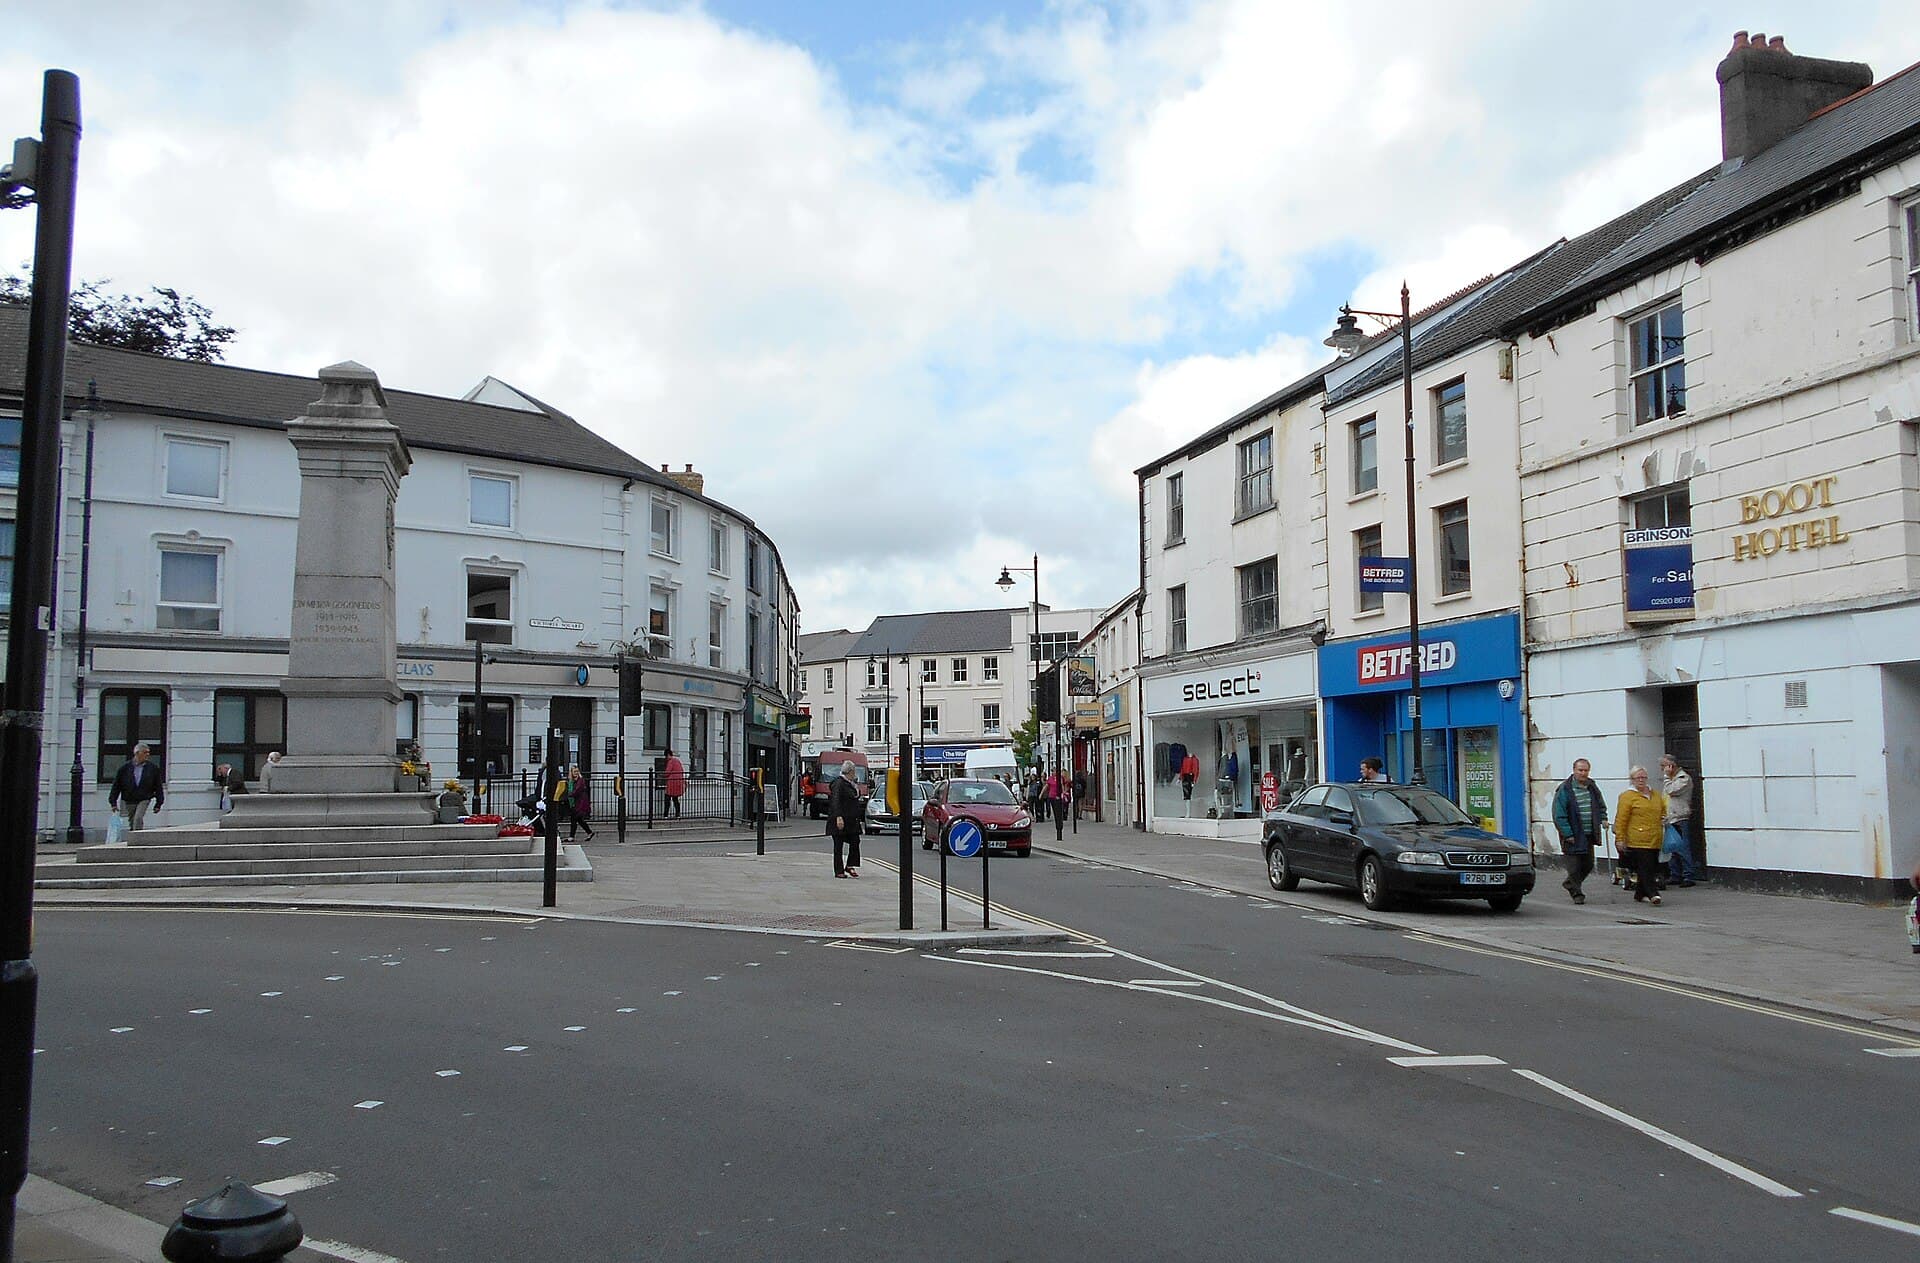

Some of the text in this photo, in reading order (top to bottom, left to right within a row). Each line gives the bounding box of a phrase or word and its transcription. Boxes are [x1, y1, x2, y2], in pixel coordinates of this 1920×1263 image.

[1738, 475, 1837, 524] BOOT
[1732, 515, 1850, 561] HOTEL
[1363, 568, 1404, 577] BETFRED
[1651, 570, 1692, 584] For Sal
[1362, 641, 1456, 679] BETFRED
[396, 663, 434, 676] CLAYS
[1466, 771, 1494, 780] BOOSTS
